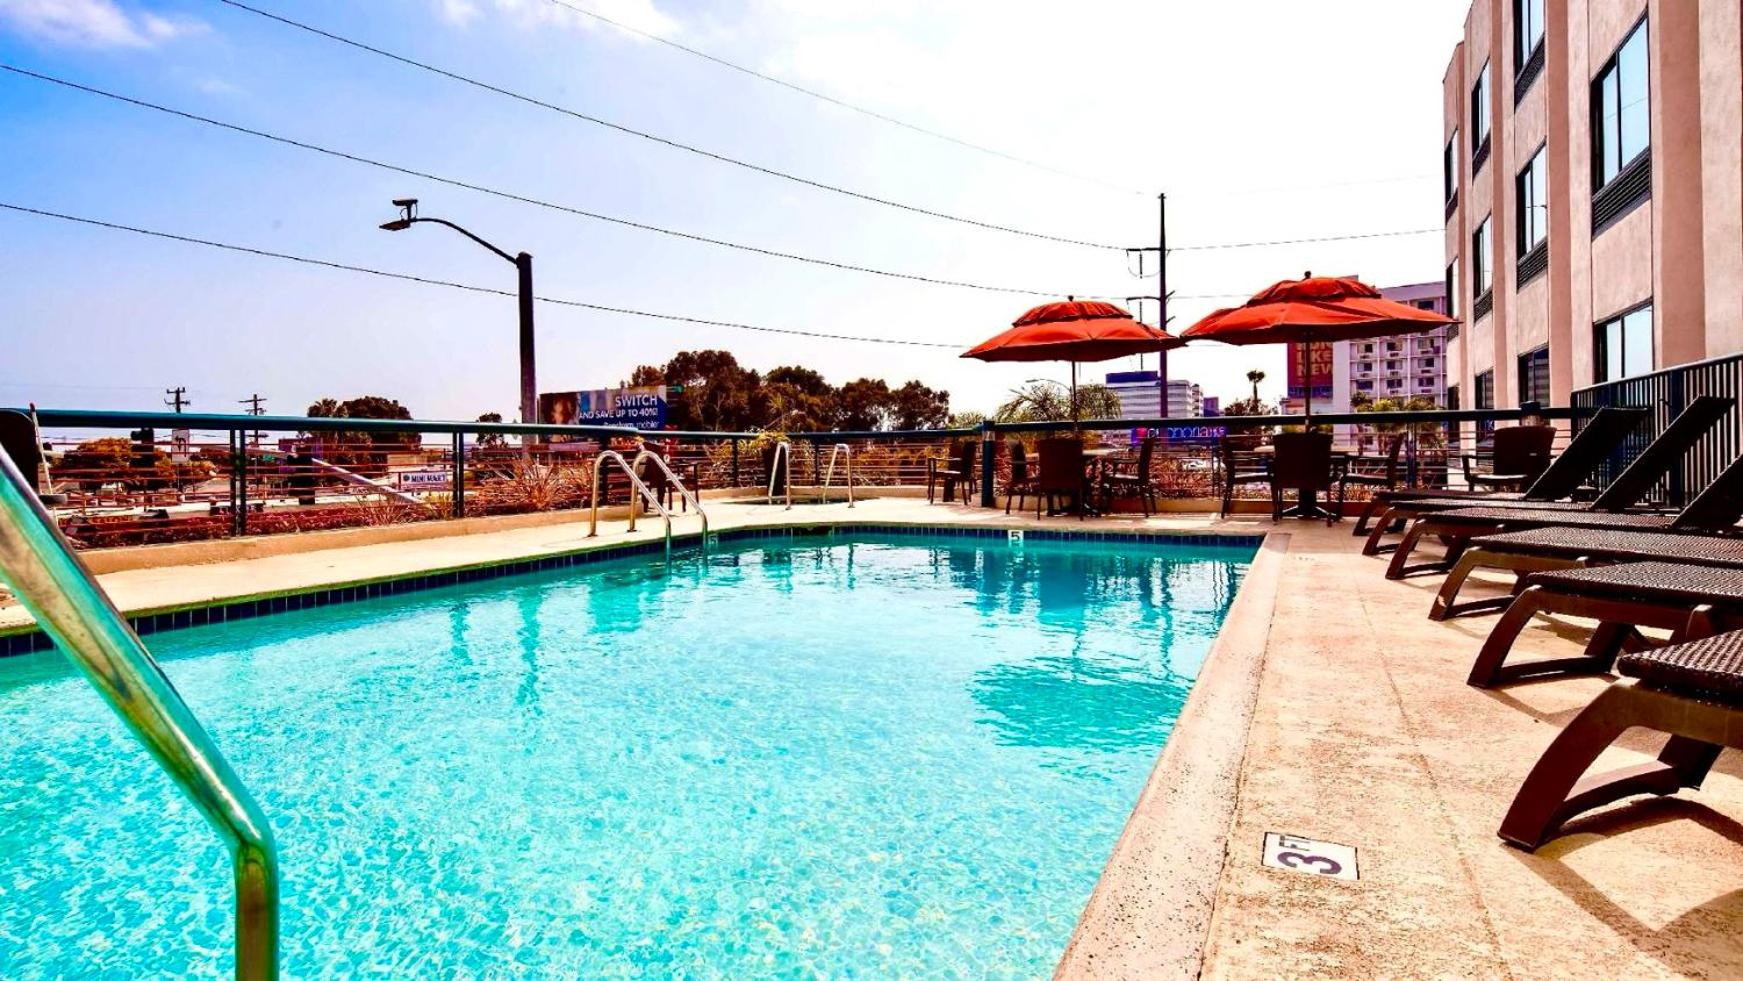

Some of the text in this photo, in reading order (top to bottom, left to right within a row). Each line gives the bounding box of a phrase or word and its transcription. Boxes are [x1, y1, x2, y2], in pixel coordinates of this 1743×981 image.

[615, 394, 658, 407] SWITCH
[579, 410, 594, 419] AND
[595, 409, 614, 418] SAVE
[615, 408, 626, 417] UP
[627, 408, 638, 416] TO
[1010, 531, 1020, 542] 5
[1277, 851, 1342, 875] 3
